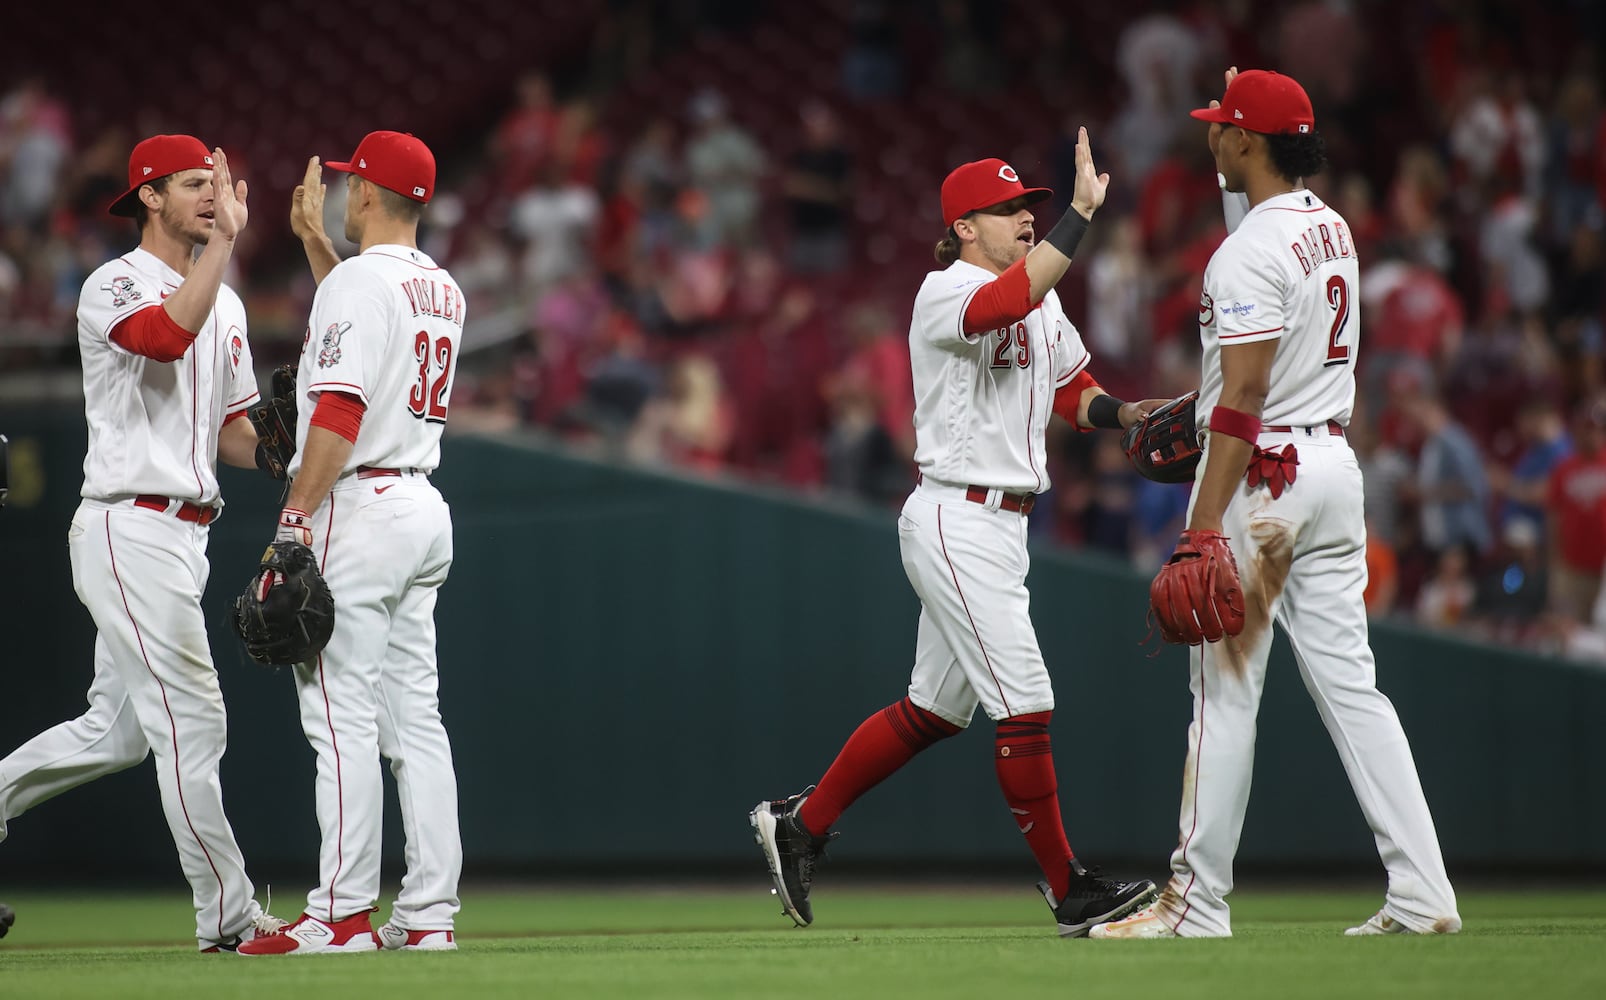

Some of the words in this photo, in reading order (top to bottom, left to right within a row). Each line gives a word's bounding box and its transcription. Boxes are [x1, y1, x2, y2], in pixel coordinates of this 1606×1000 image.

[998, 164, 1019, 182] C
[401, 277, 462, 328] VOSLER
[1323, 274, 1351, 368] 2
[991, 321, 1031, 369] 29
[407, 330, 452, 425] 32
